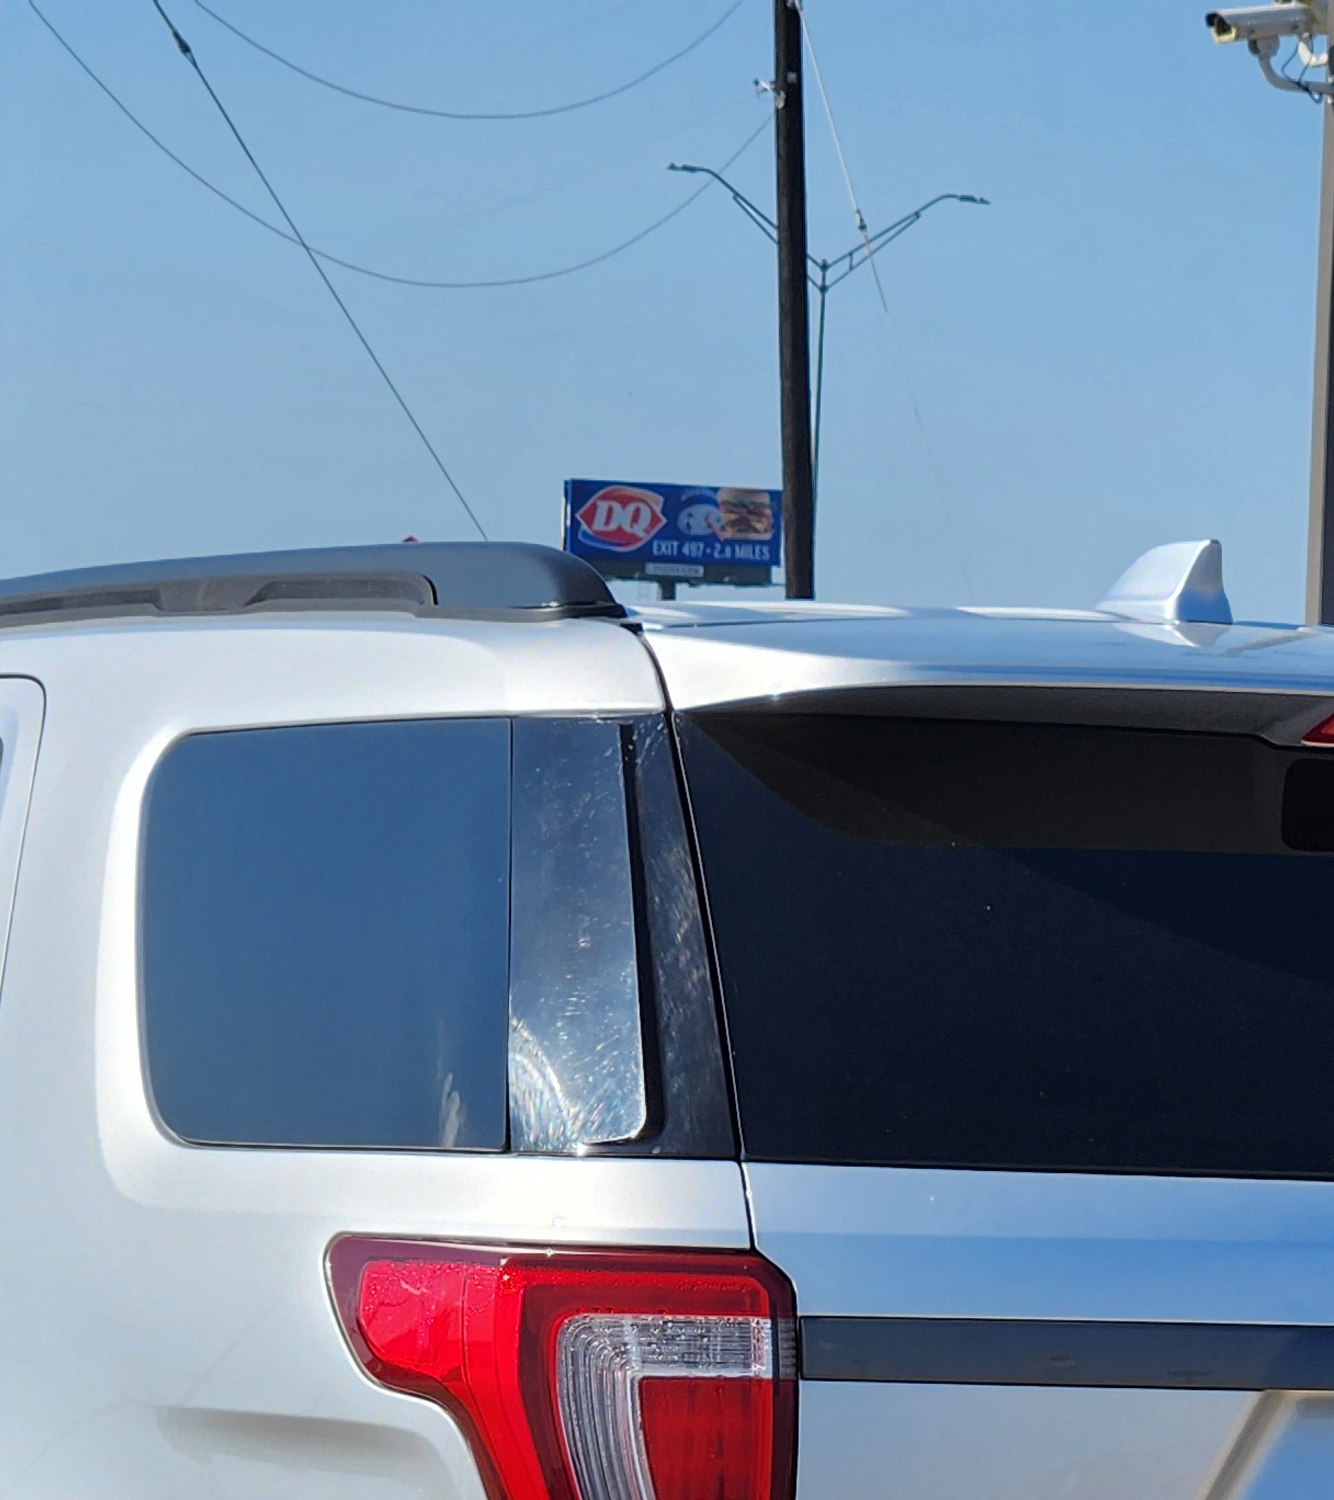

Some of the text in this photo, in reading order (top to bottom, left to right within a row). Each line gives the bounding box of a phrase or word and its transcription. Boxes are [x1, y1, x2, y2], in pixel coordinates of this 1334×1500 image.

[592, 500, 652, 538] DQ
[652, 540, 679, 556] EXIT
[682, 541, 705, 558] 497
[735, 544, 770, 561] MILES
